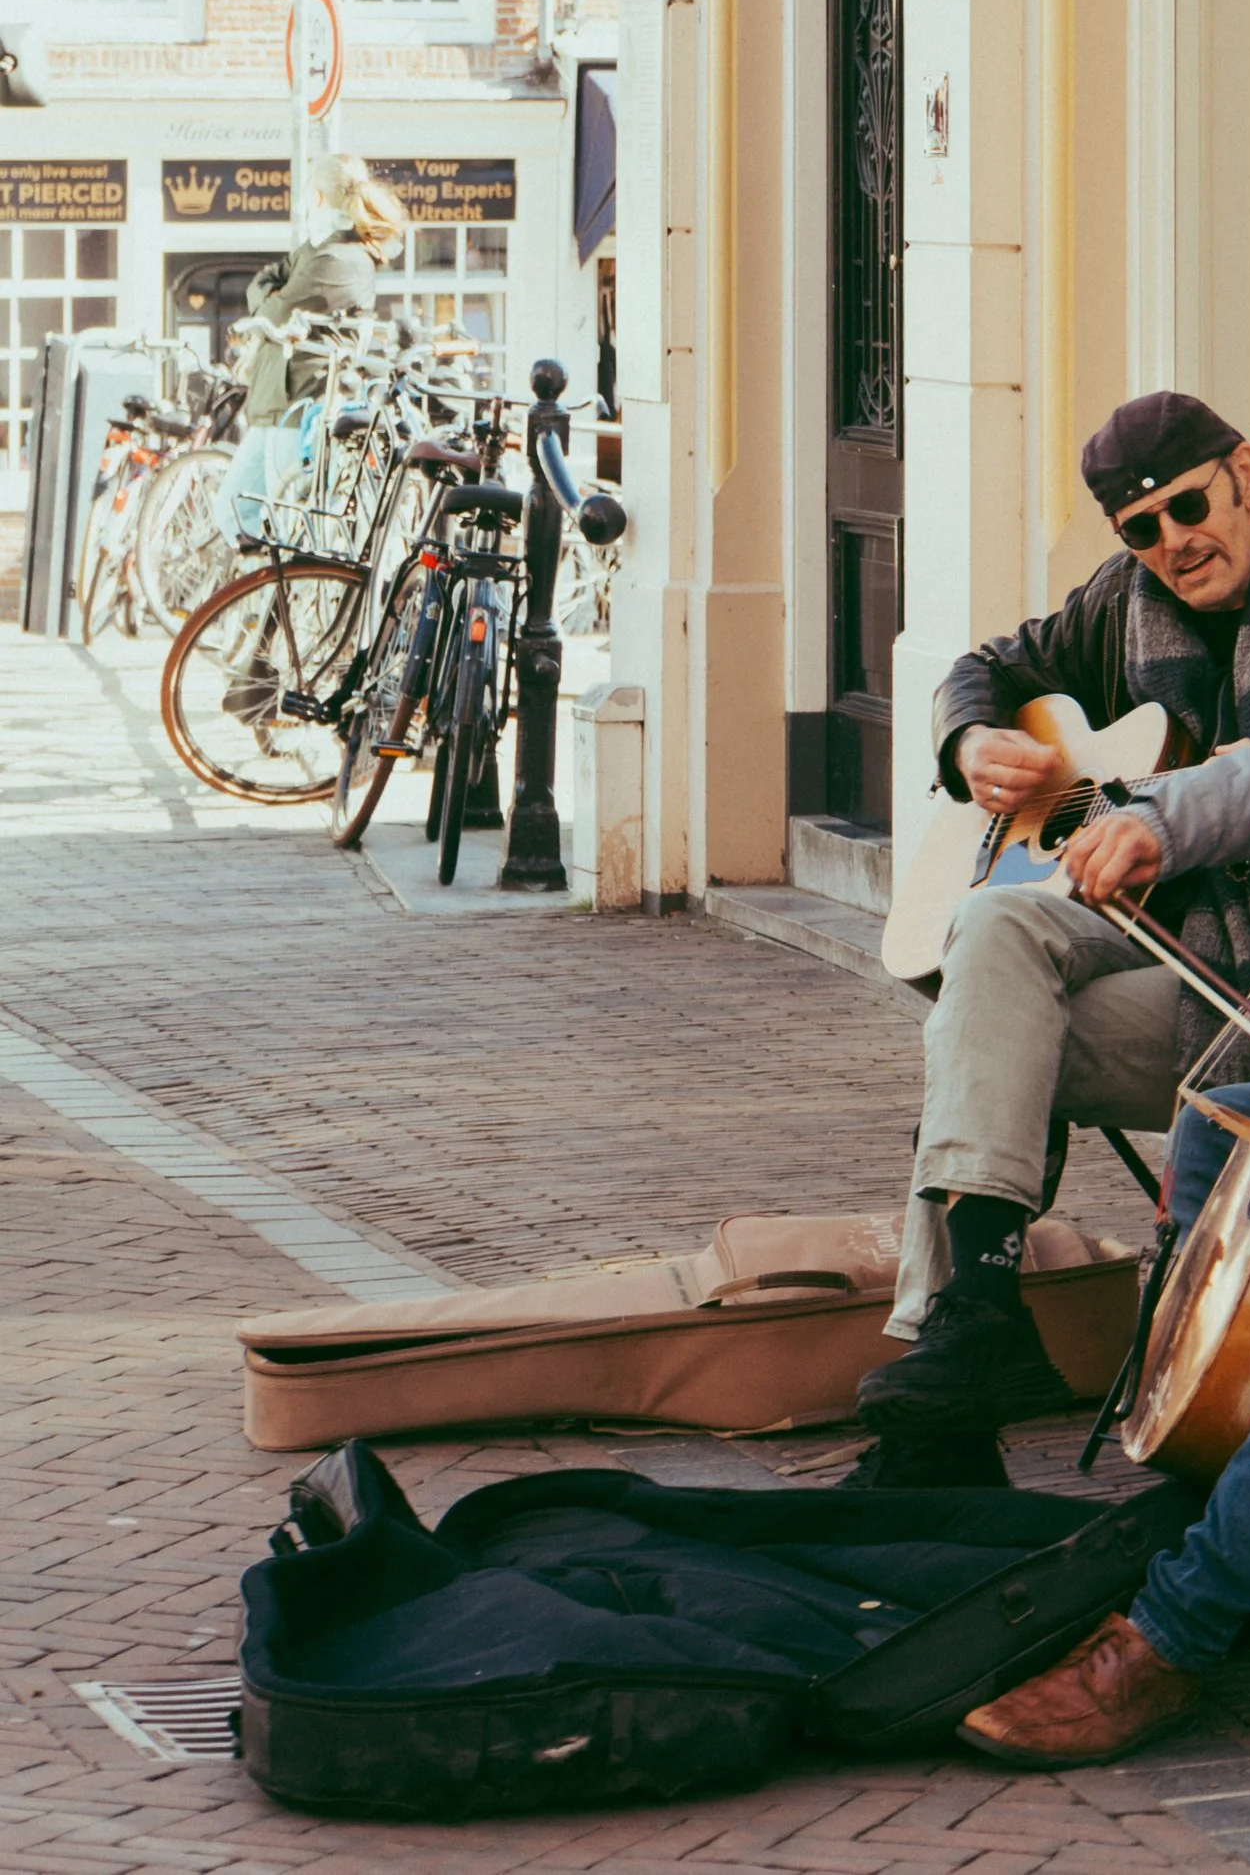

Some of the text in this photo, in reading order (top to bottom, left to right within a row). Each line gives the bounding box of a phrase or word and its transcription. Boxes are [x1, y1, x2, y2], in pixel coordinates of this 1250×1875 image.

[10, 164, 40, 181] only
[42, 164, 68, 179] live
[69, 164, 108, 179] once!
[414, 159, 460, 177] Your
[393, 181, 513, 203] cing Experts
[226, 191, 290, 212] Pierci
[19, 207, 56, 220] maar
[87, 205, 122, 220] keer!
[412, 203, 483, 220] Utrecht
[979, 1252, 1017, 1270] LOT
